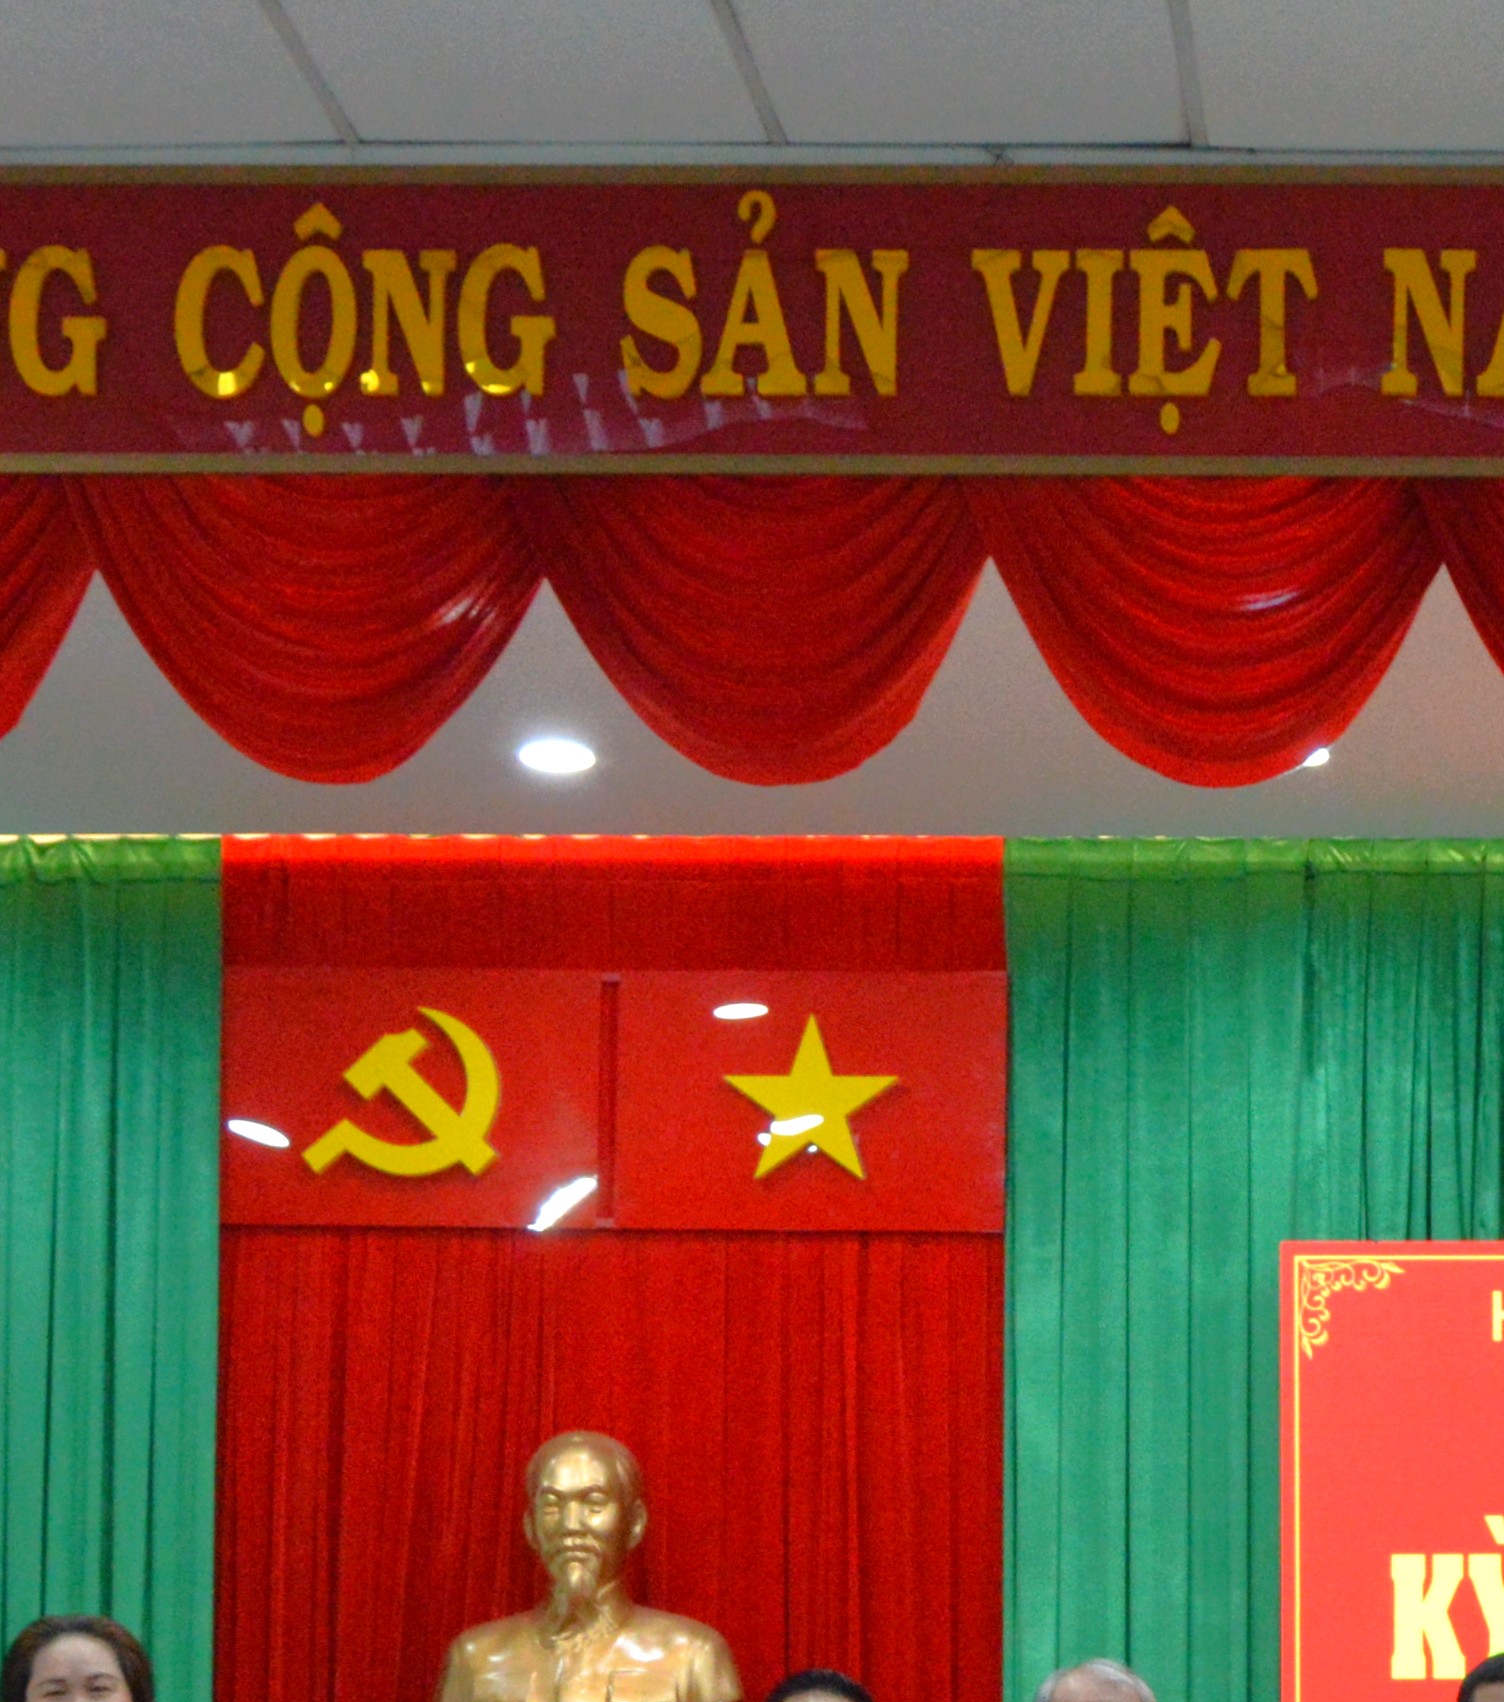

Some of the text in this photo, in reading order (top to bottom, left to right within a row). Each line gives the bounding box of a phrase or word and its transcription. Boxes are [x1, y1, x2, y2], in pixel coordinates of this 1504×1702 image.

[172, 203, 556, 438] CỘNG
[619, 189, 908, 397] SẢN
[971, 206, 1319, 435] VIỆT
